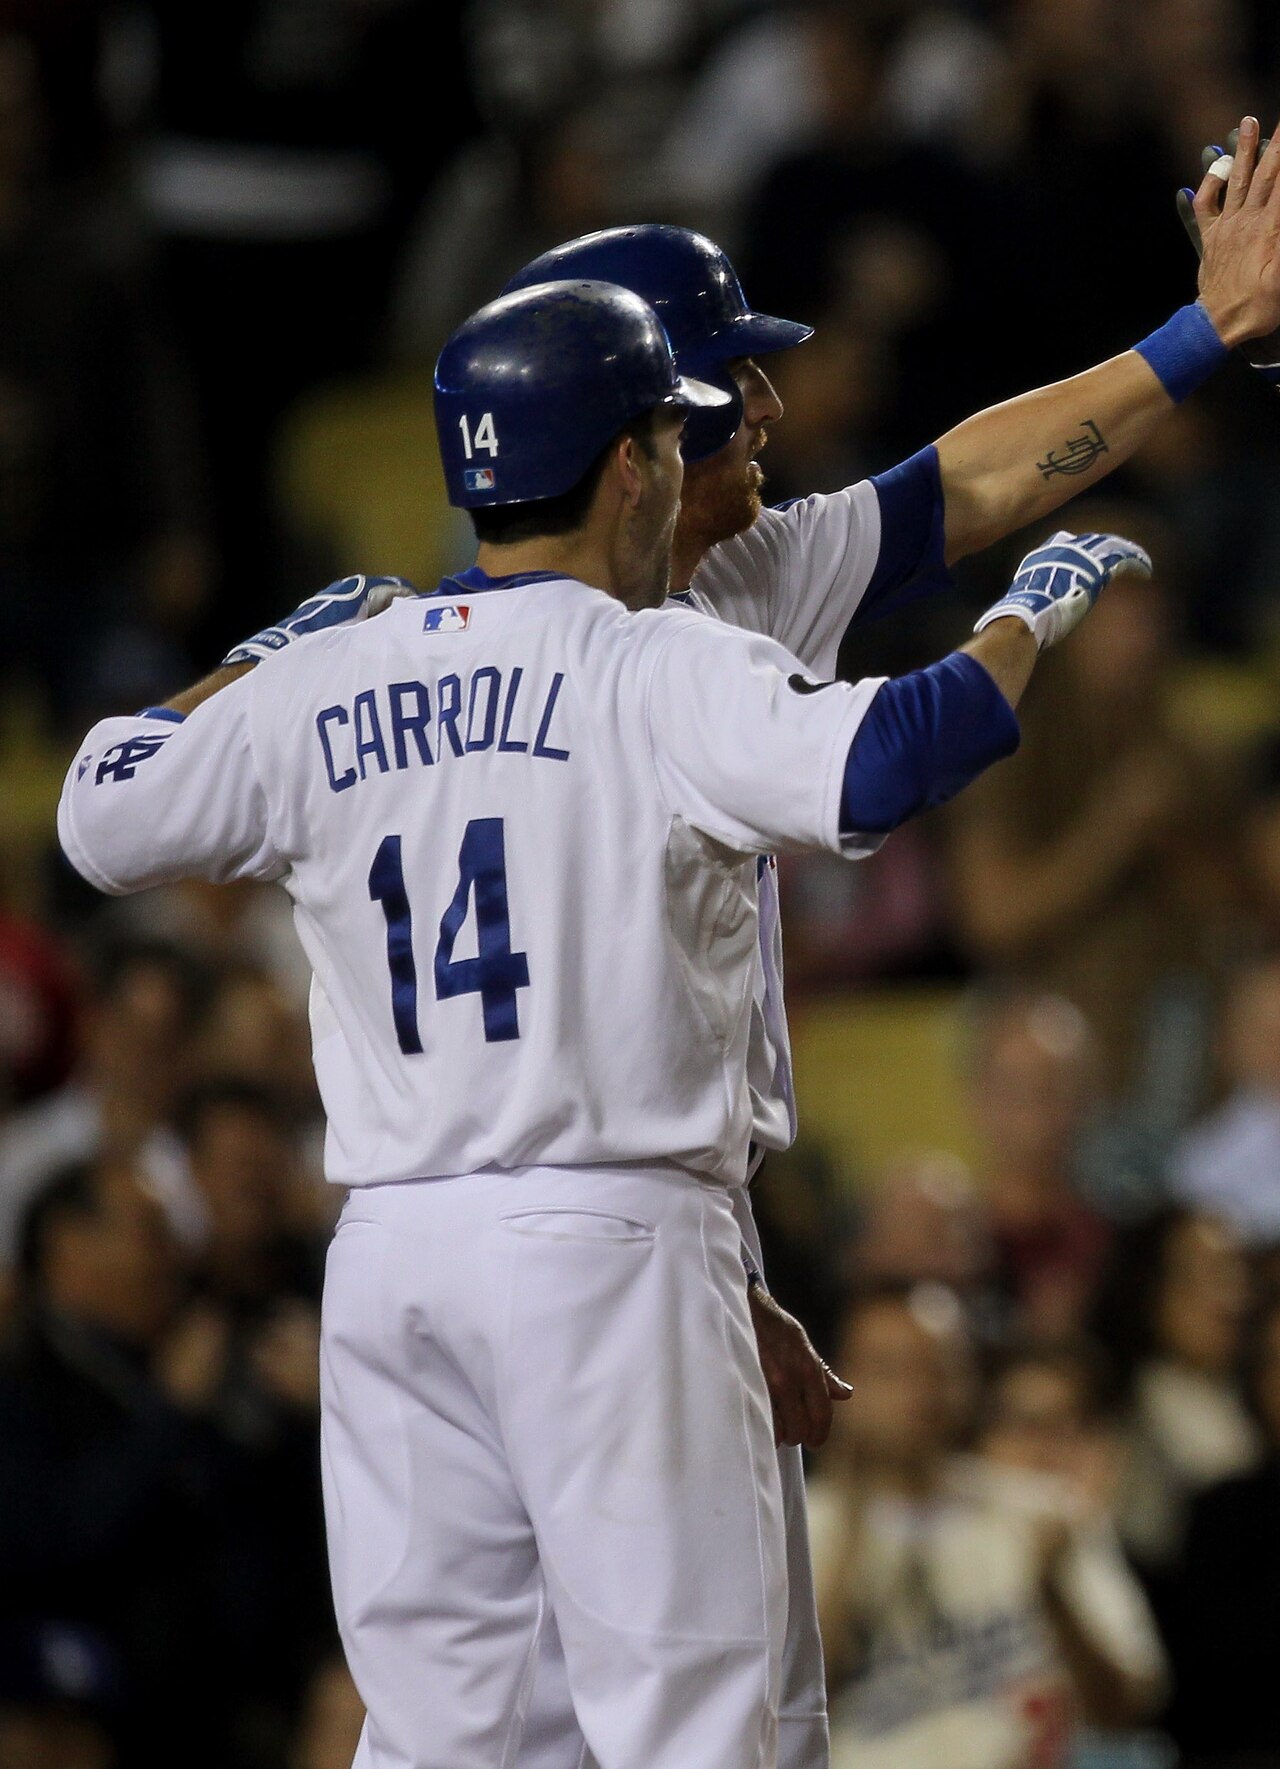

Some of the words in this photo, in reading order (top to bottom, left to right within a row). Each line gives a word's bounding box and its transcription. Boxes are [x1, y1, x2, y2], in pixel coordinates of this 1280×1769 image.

[459, 412, 499, 459] 14
[316, 666, 570, 793] CARROLL
[368, 817, 530, 1055] 14
